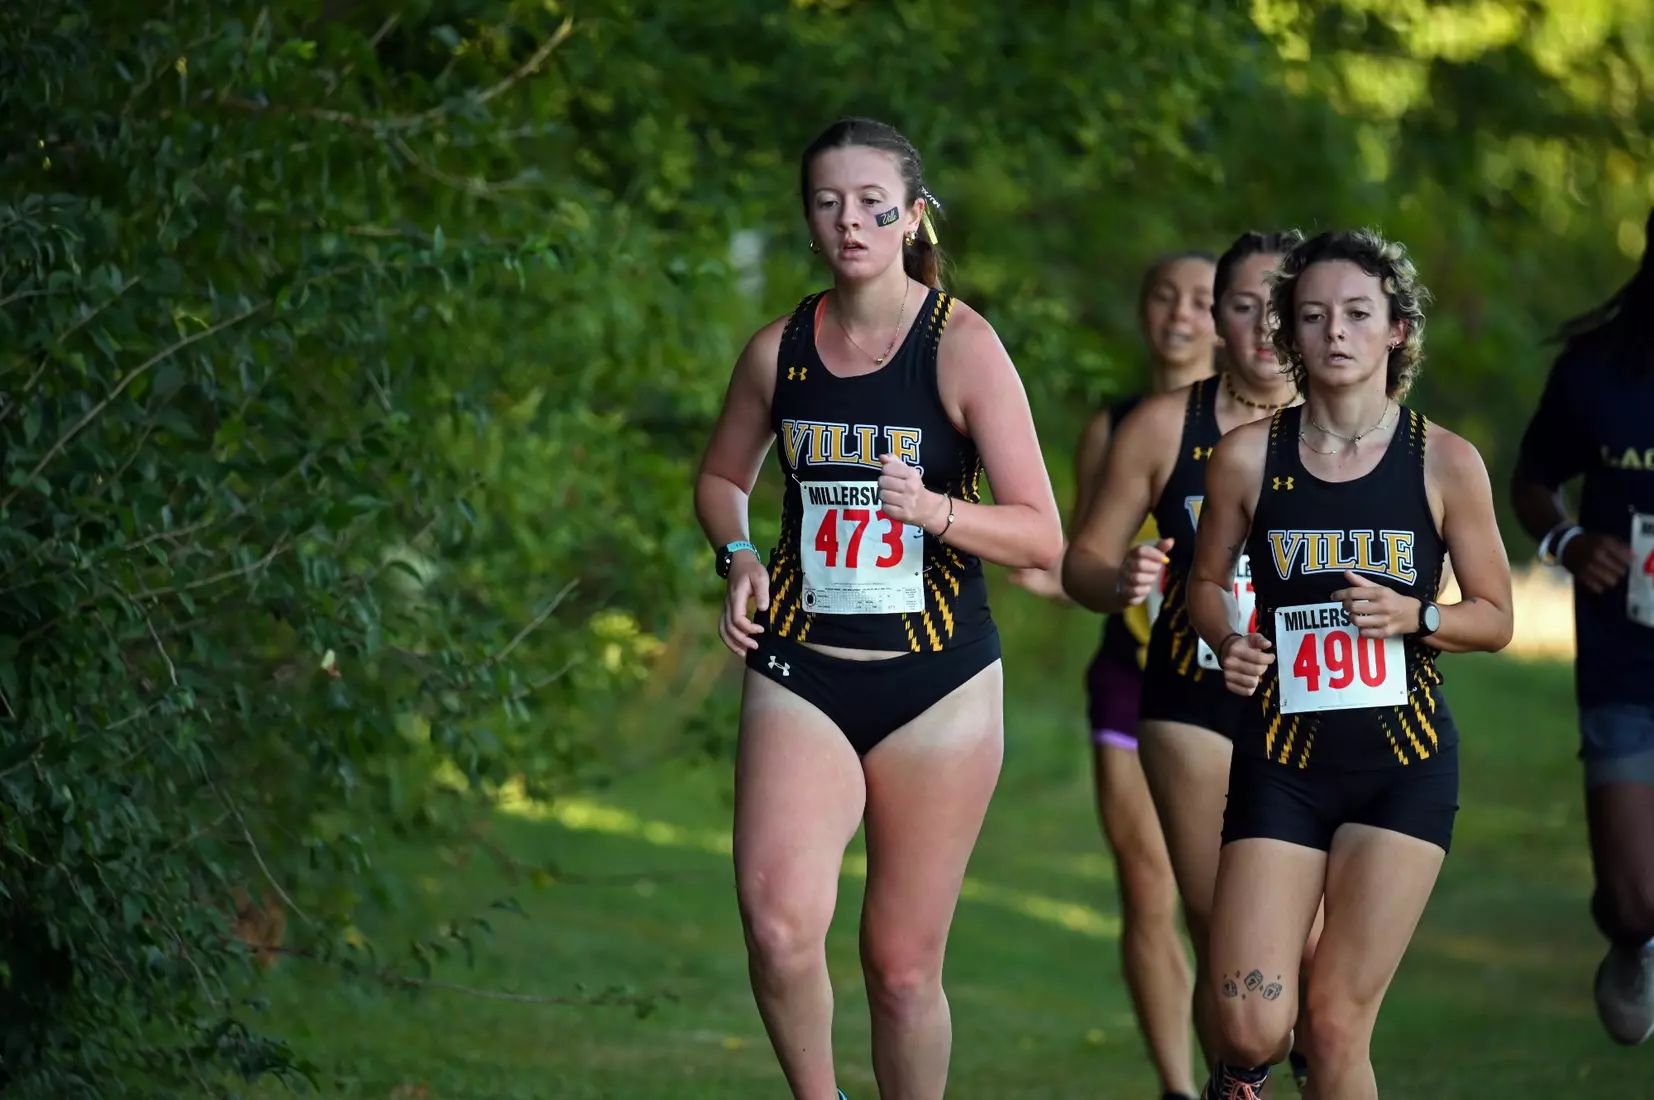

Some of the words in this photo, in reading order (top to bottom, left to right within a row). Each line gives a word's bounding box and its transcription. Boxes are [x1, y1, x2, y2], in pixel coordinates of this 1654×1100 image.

[782, 419, 924, 480] VILLE
[815, 509, 904, 568] 473
[1267, 530, 1417, 586] VILLE
[1284, 608, 1351, 632] MILLERS
[1293, 630, 1387, 692] 490
